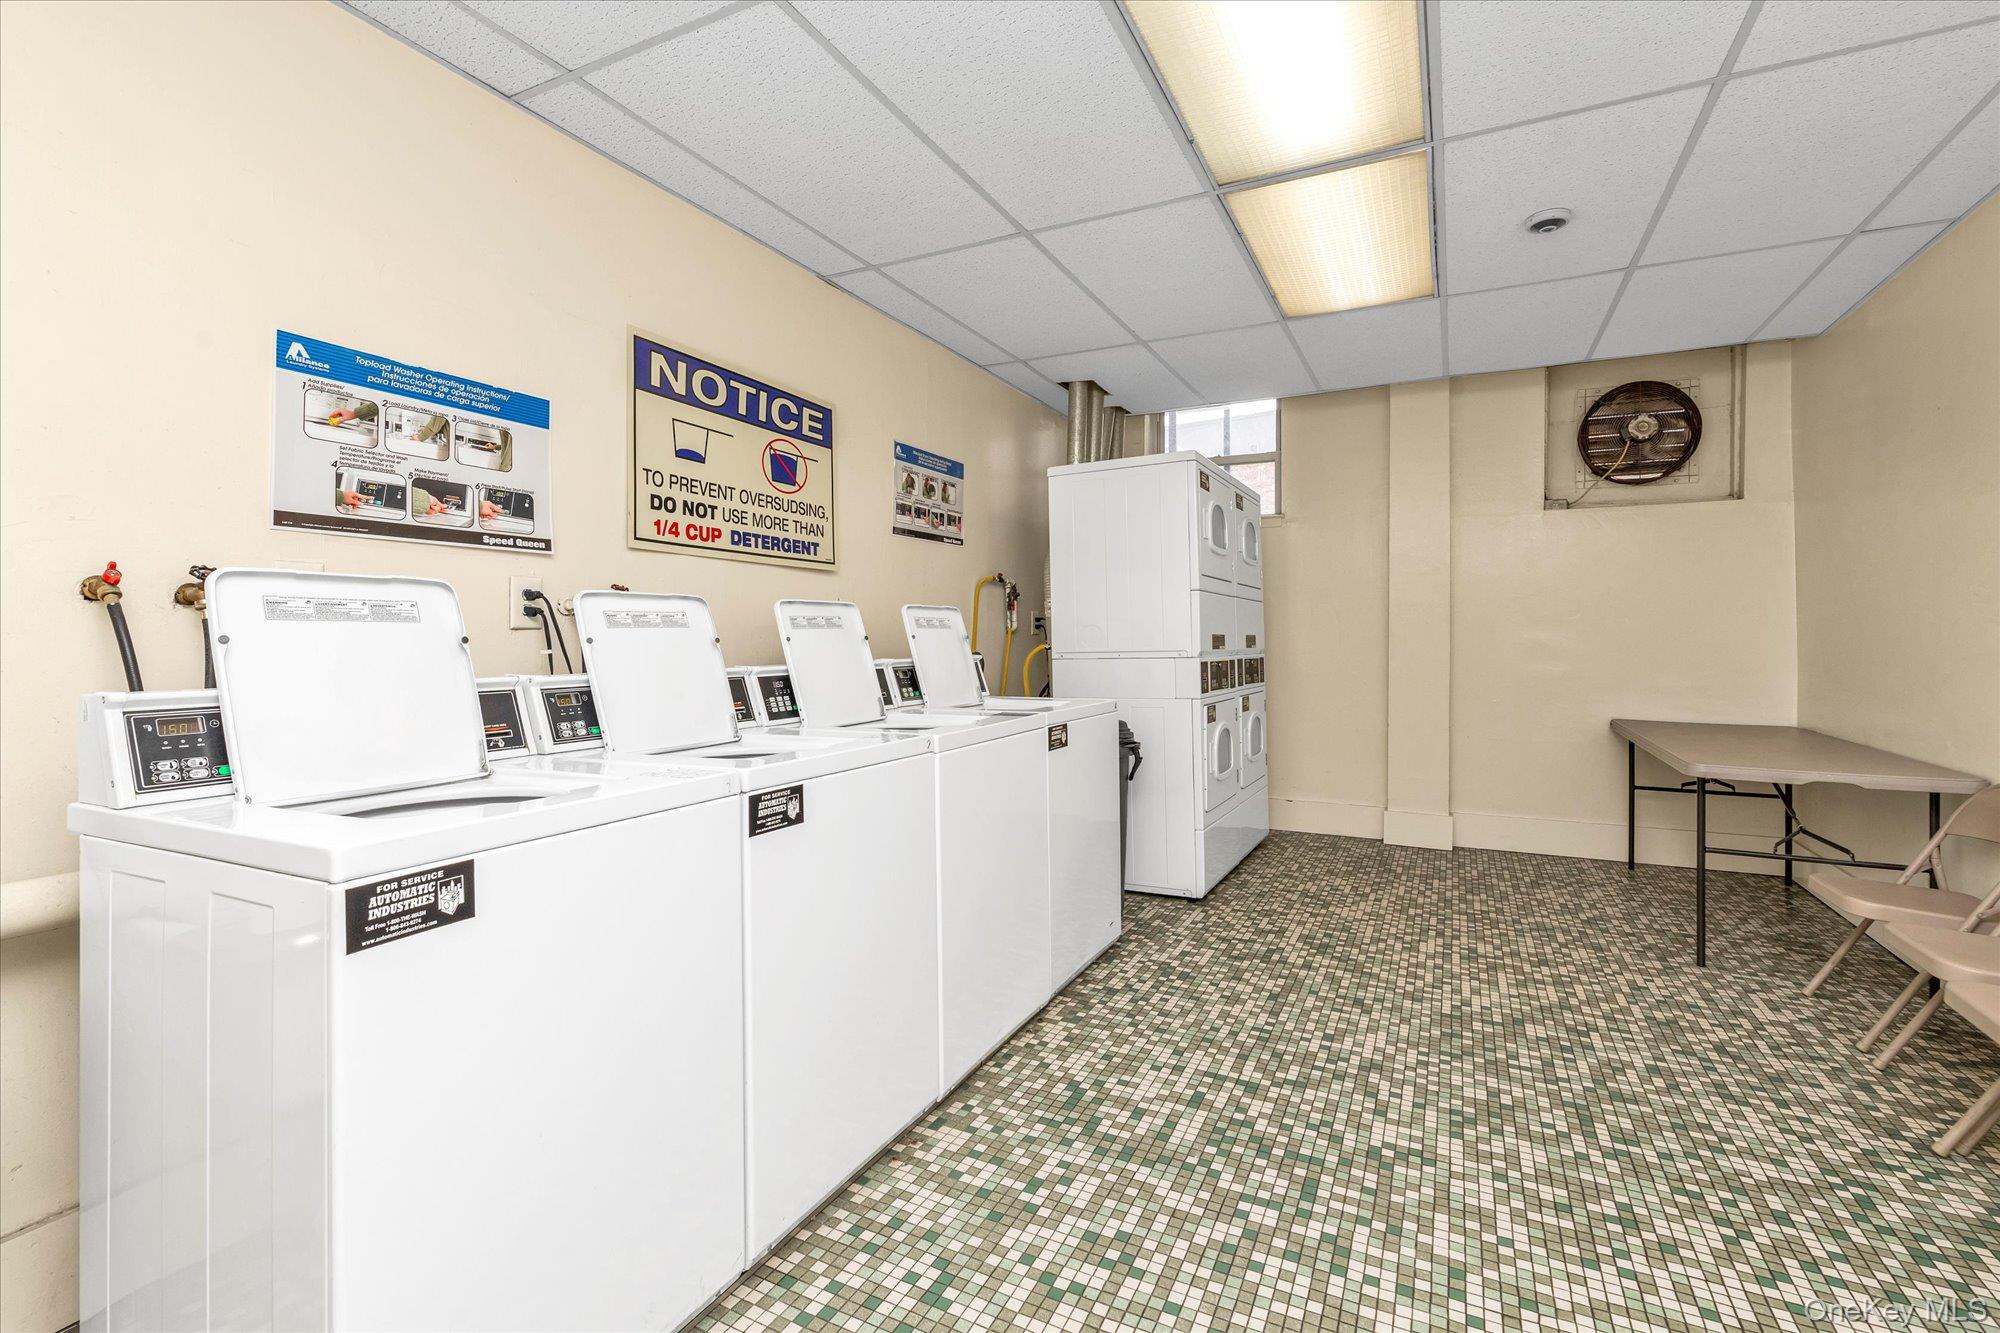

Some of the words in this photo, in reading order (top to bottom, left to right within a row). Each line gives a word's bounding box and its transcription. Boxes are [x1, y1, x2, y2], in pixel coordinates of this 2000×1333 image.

[288, 354, 330, 369] Alliance
[355, 356, 391, 371] Topload
[394, 366, 423, 379] Washer
[426, 374, 465, 390] Operating
[467, 385, 510, 402] Instructions/
[368, 376, 389, 385] para
[391, 380, 432, 395] lavadoras
[434, 391, 444, 399] de
[447, 394, 470, 405] carga
[471, 400, 500, 412] superior
[382, 371, 436, 389] Instrucciones
[451, 389, 490, 402] operación
[650, 350, 823, 440] NOTICE
[642, 467, 664, 488] TO
[669, 474, 735, 502] PREVENT
[739, 489, 829, 522] OVERSUDSING,
[650, 493, 677, 513] DO
[682, 500, 718, 520] NOT
[722, 509, 748, 526] USE
[752, 512, 789, 533] MORE
[792, 519, 824, 538] THAN
[482, 535, 514, 546] Speed
[516, 538, 545, 548] Queen
[653, 519, 680, 538] 1/4
[685, 523, 722, 543] CUP
[730, 529, 820, 556] DETERGENT
[368, 881, 436, 908] AUTOMATIC
[376, 882, 398, 894] FOR
[401, 870, 444, 887] SERVICE
[368, 893, 435, 921] INDUSTRIES
